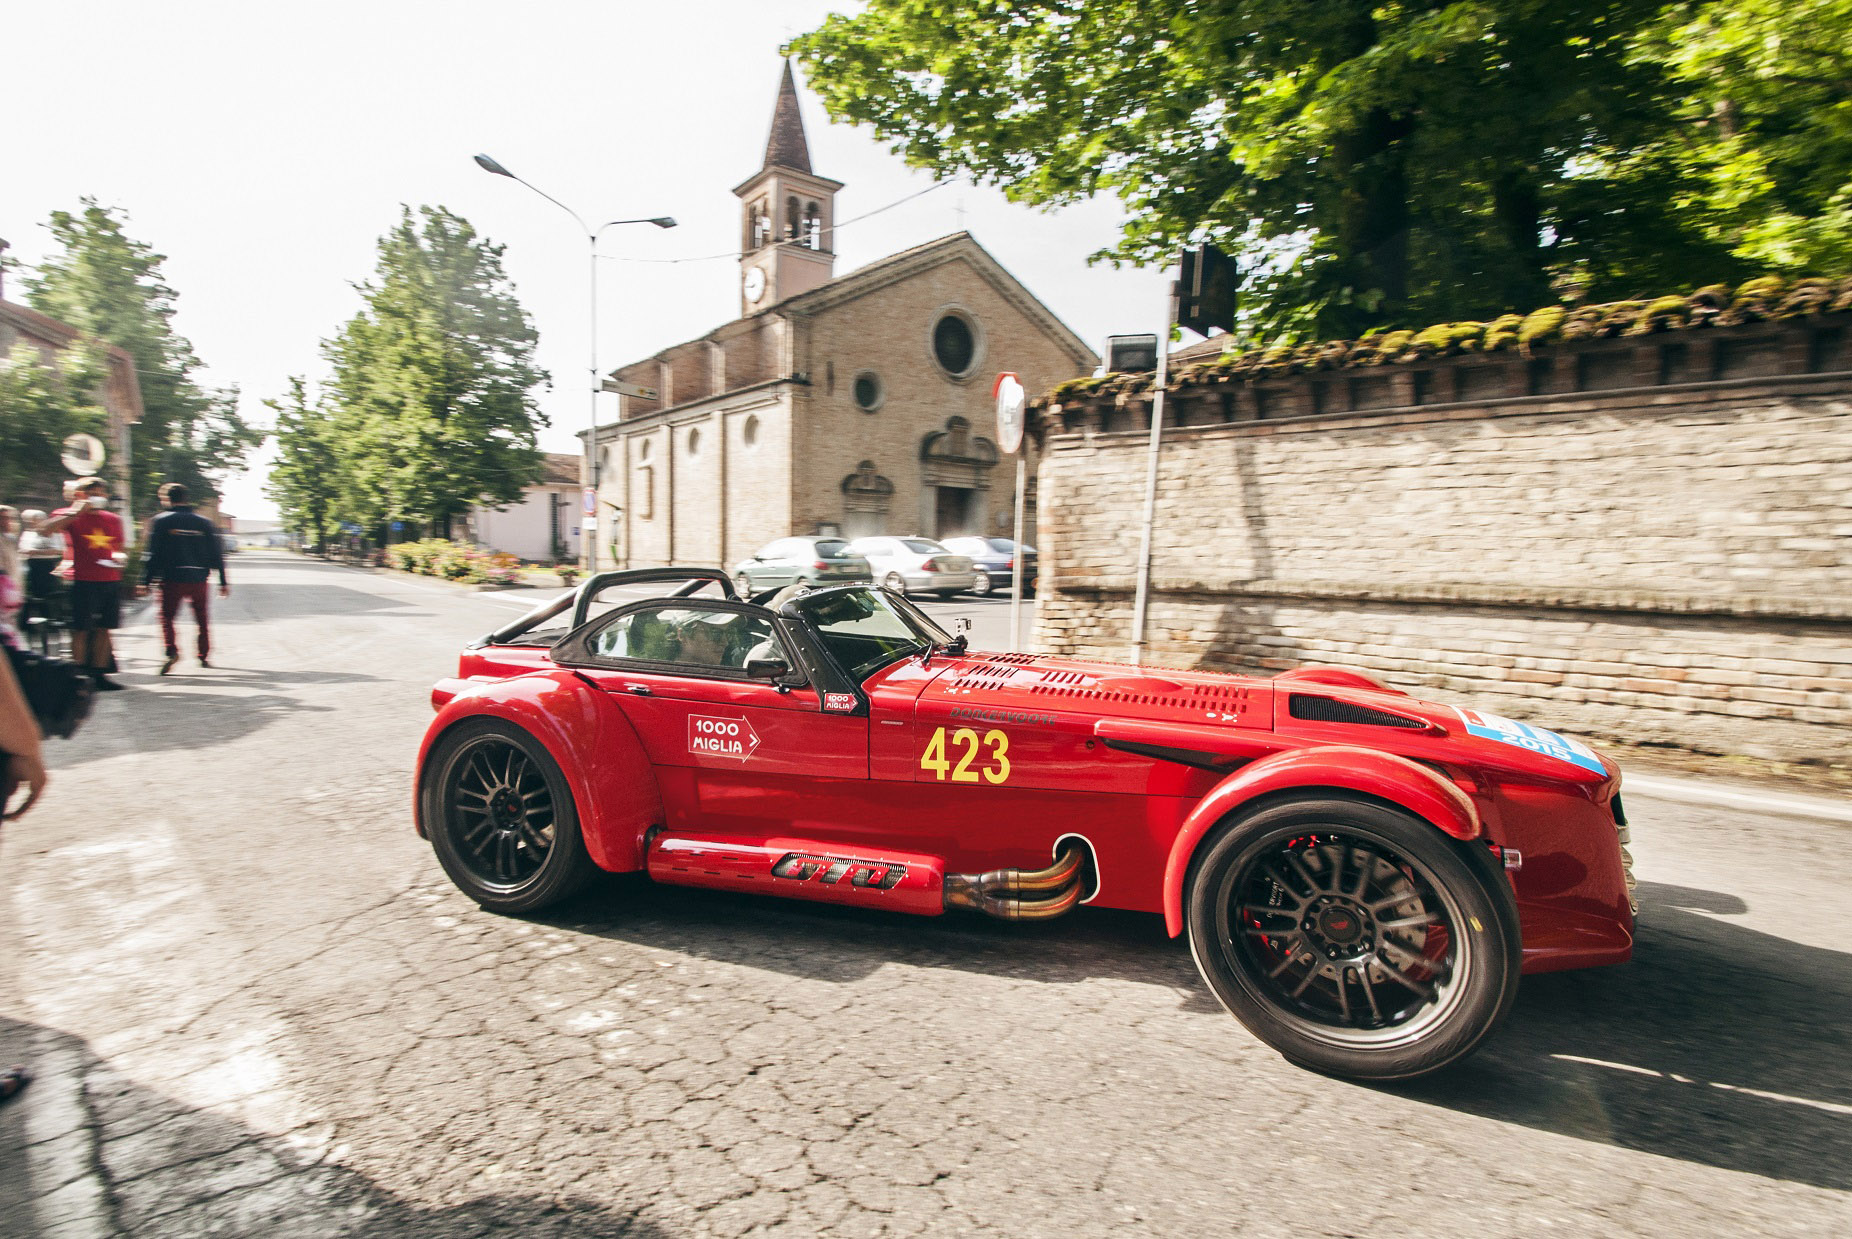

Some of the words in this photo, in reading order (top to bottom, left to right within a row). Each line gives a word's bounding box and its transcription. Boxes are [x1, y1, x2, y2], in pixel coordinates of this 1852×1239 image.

[826, 702, 850, 710] MIGLIA
[696, 720, 739, 736] 1000
[693, 737, 743, 754] MIGLIA
[1502, 732, 1571, 760] 2015
[920, 727, 1011, 785] 423
